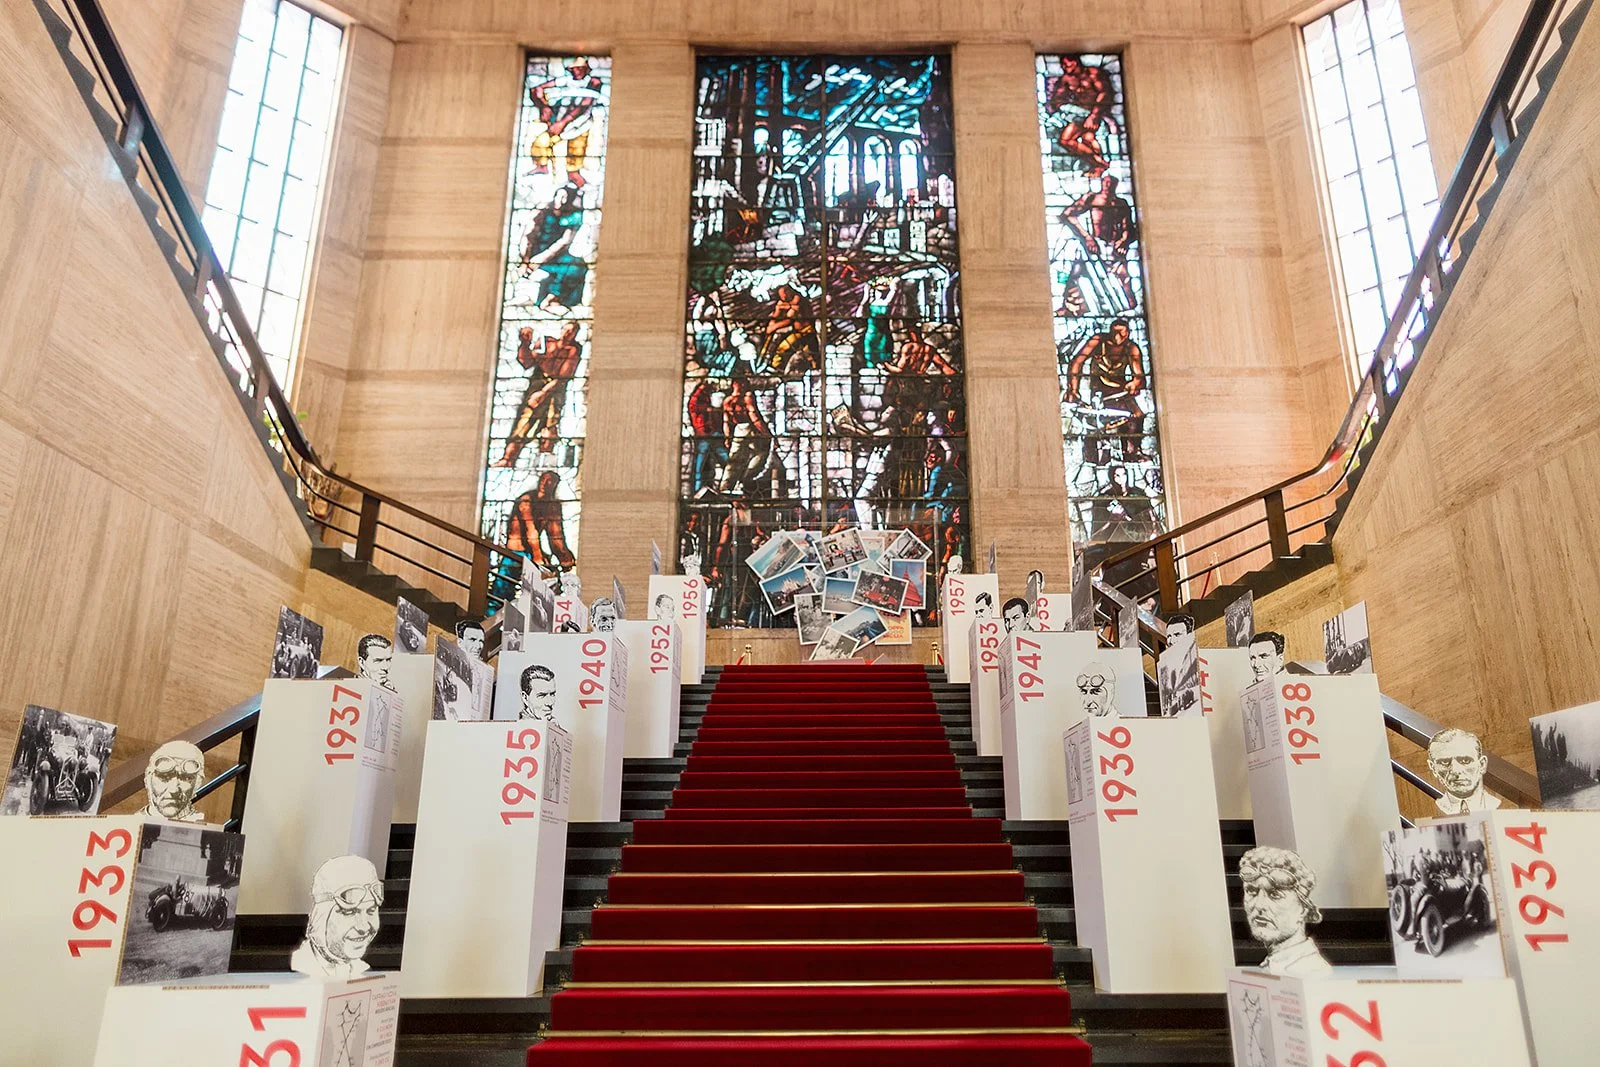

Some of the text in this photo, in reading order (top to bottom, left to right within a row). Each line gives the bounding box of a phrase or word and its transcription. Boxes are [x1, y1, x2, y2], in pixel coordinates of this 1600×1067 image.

[682, 579, 699, 619] 1956
[949, 577, 966, 616] 1957
[578, 639, 607, 710] 1940
[649, 625, 671, 674] 1952
[979, 622, 999, 673] 1953
[1015, 636, 1045, 703] 1947
[324, 684, 362, 766] 1937
[1282, 682, 1321, 765] 1938
[500, 728, 541, 826] 1935
[1097, 725, 1139, 823] 1936
[67, 827, 133, 959] 1933
[1504, 821, 1569, 952] 1934
